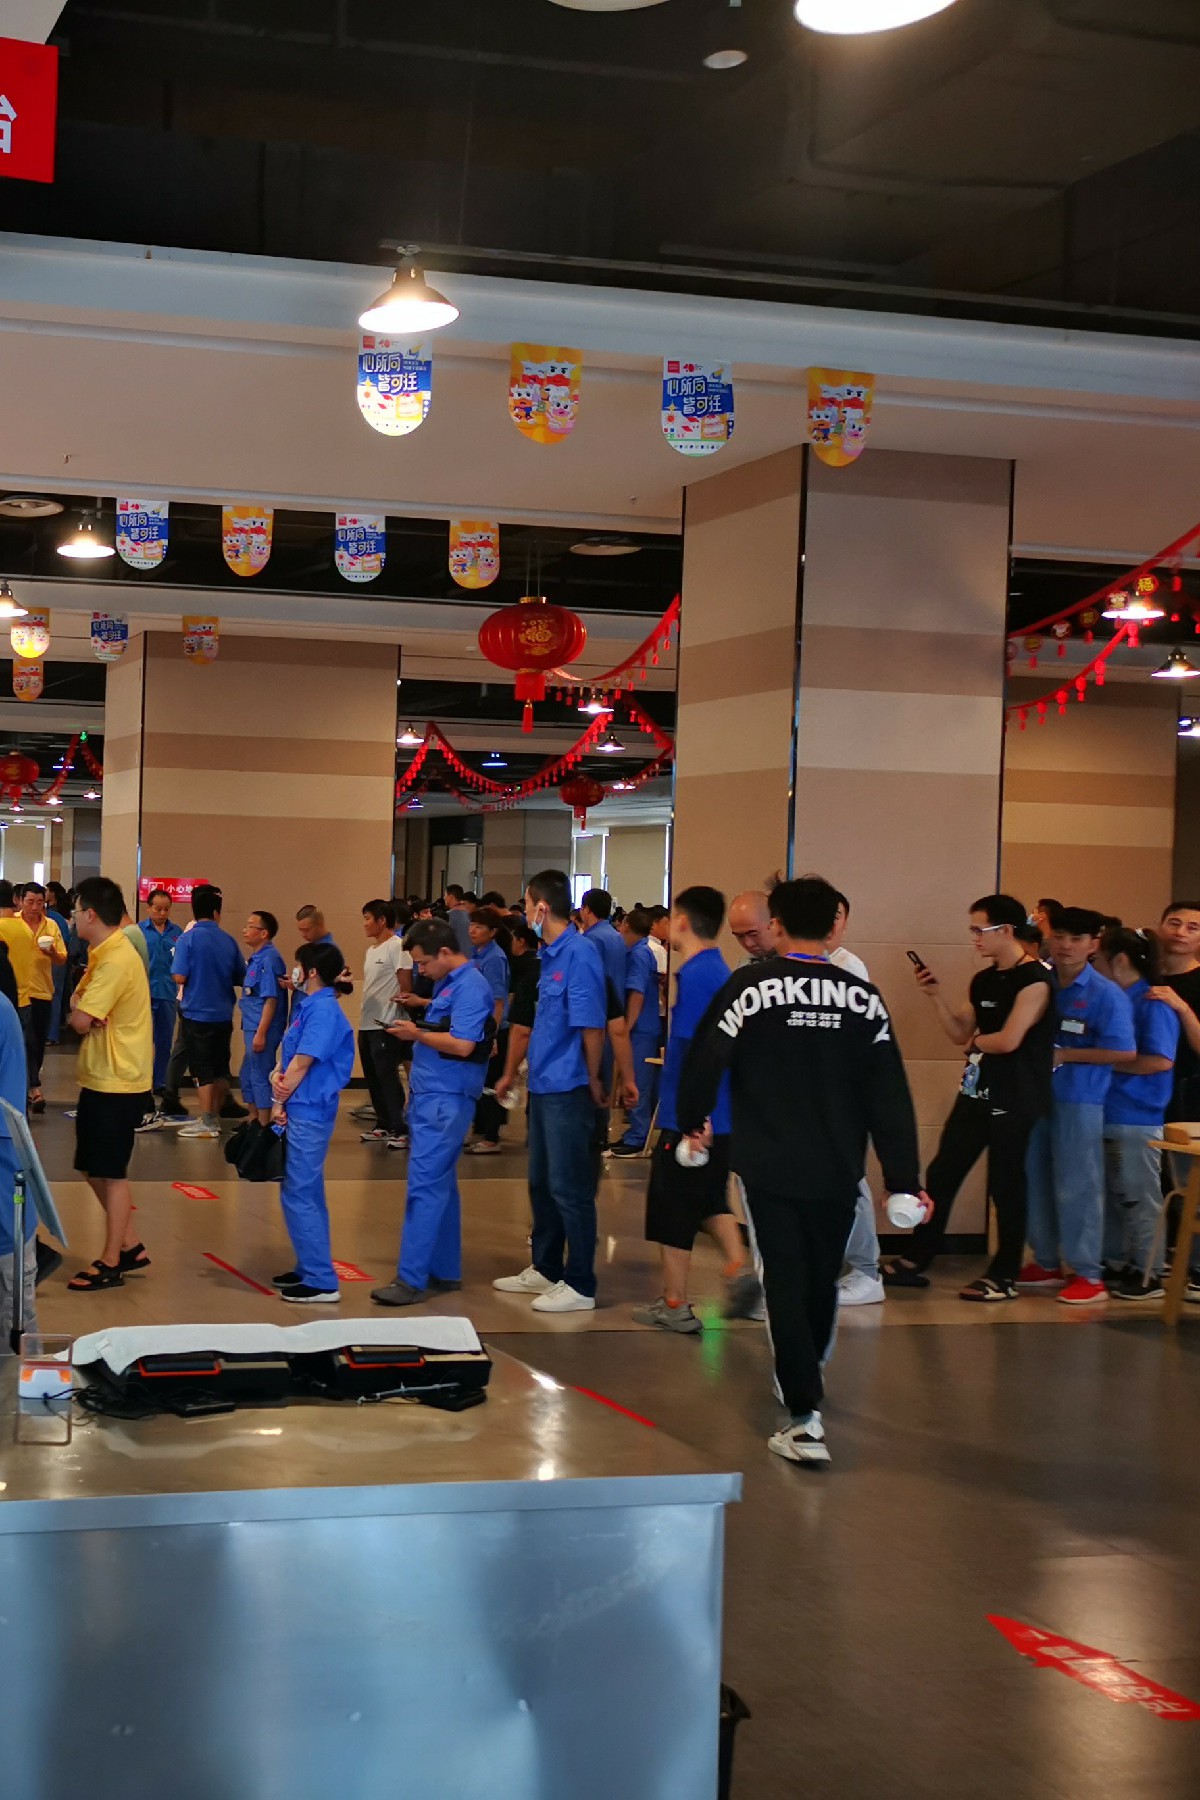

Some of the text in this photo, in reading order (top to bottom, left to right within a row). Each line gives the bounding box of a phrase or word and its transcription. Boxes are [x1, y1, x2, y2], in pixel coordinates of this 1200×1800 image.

[362, 353, 401, 373] 心所向
[377, 372, 418, 394] 皆可往
[667, 376, 706, 397] 心所向
[683, 395, 722, 415] 皆可往
[1137, 577, 1154, 592] 福
